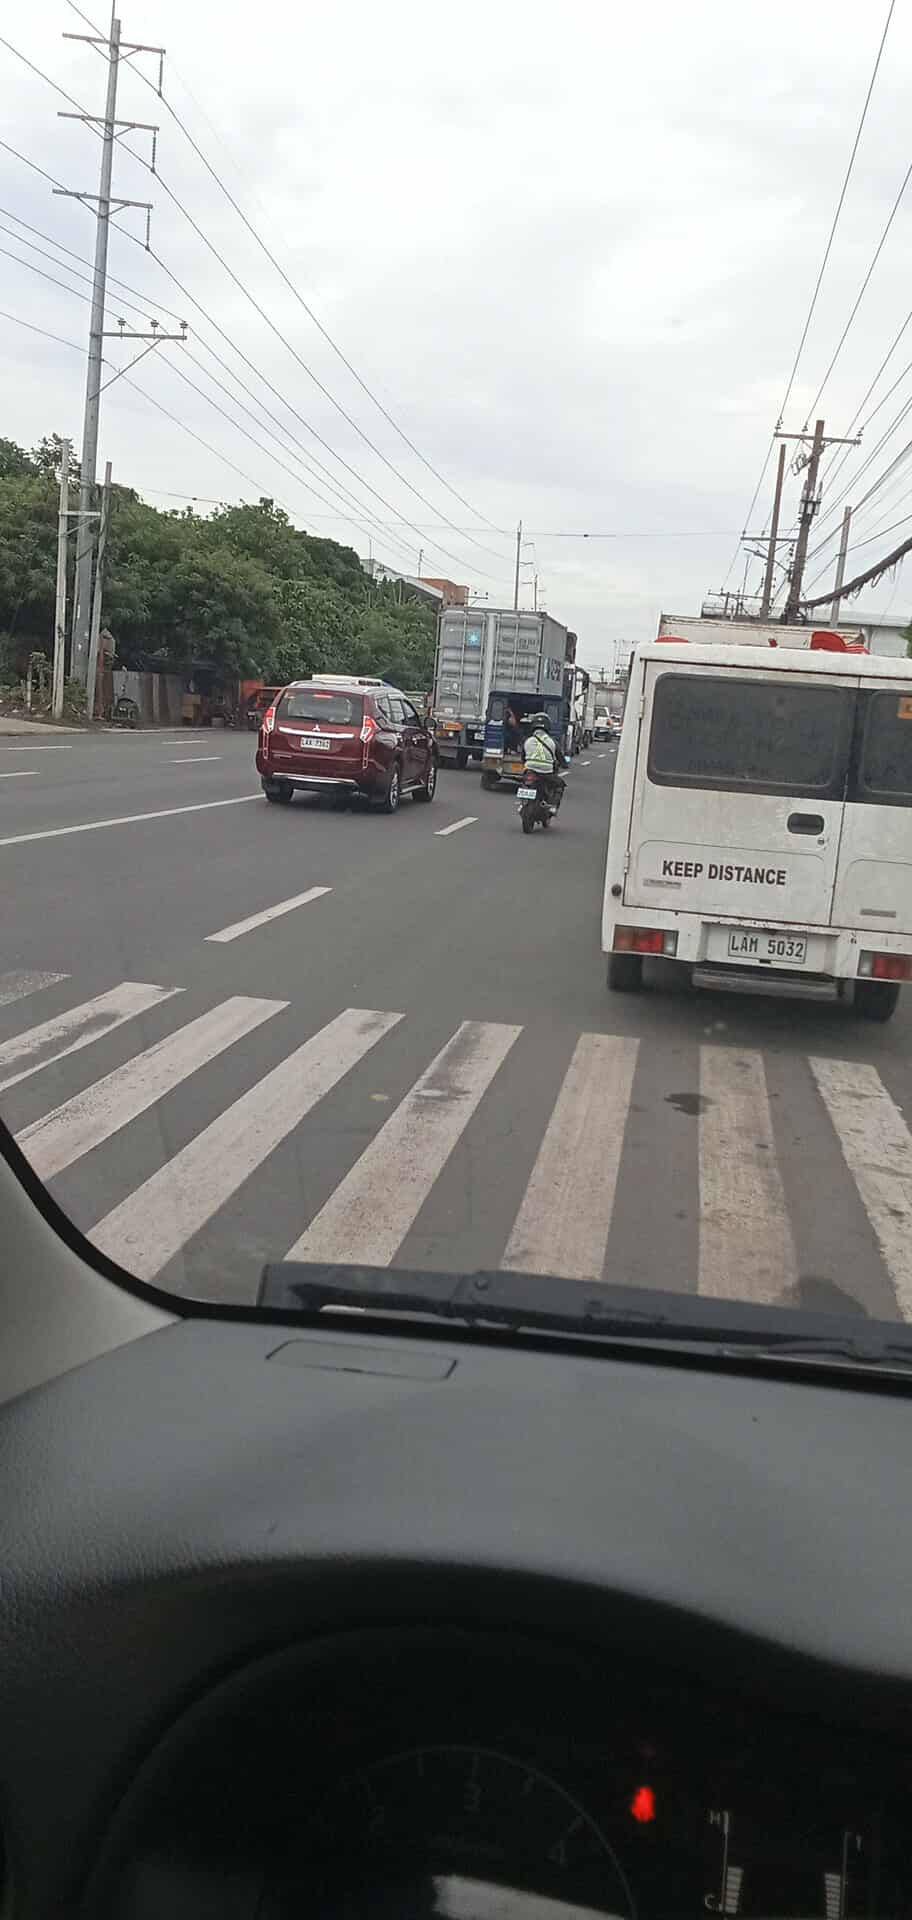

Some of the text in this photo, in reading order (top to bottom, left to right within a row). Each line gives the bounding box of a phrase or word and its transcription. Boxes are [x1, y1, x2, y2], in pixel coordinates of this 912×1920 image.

[662, 860, 787, 886] KEEP DISTANCE
[731, 935, 804, 958] LAM 5032
